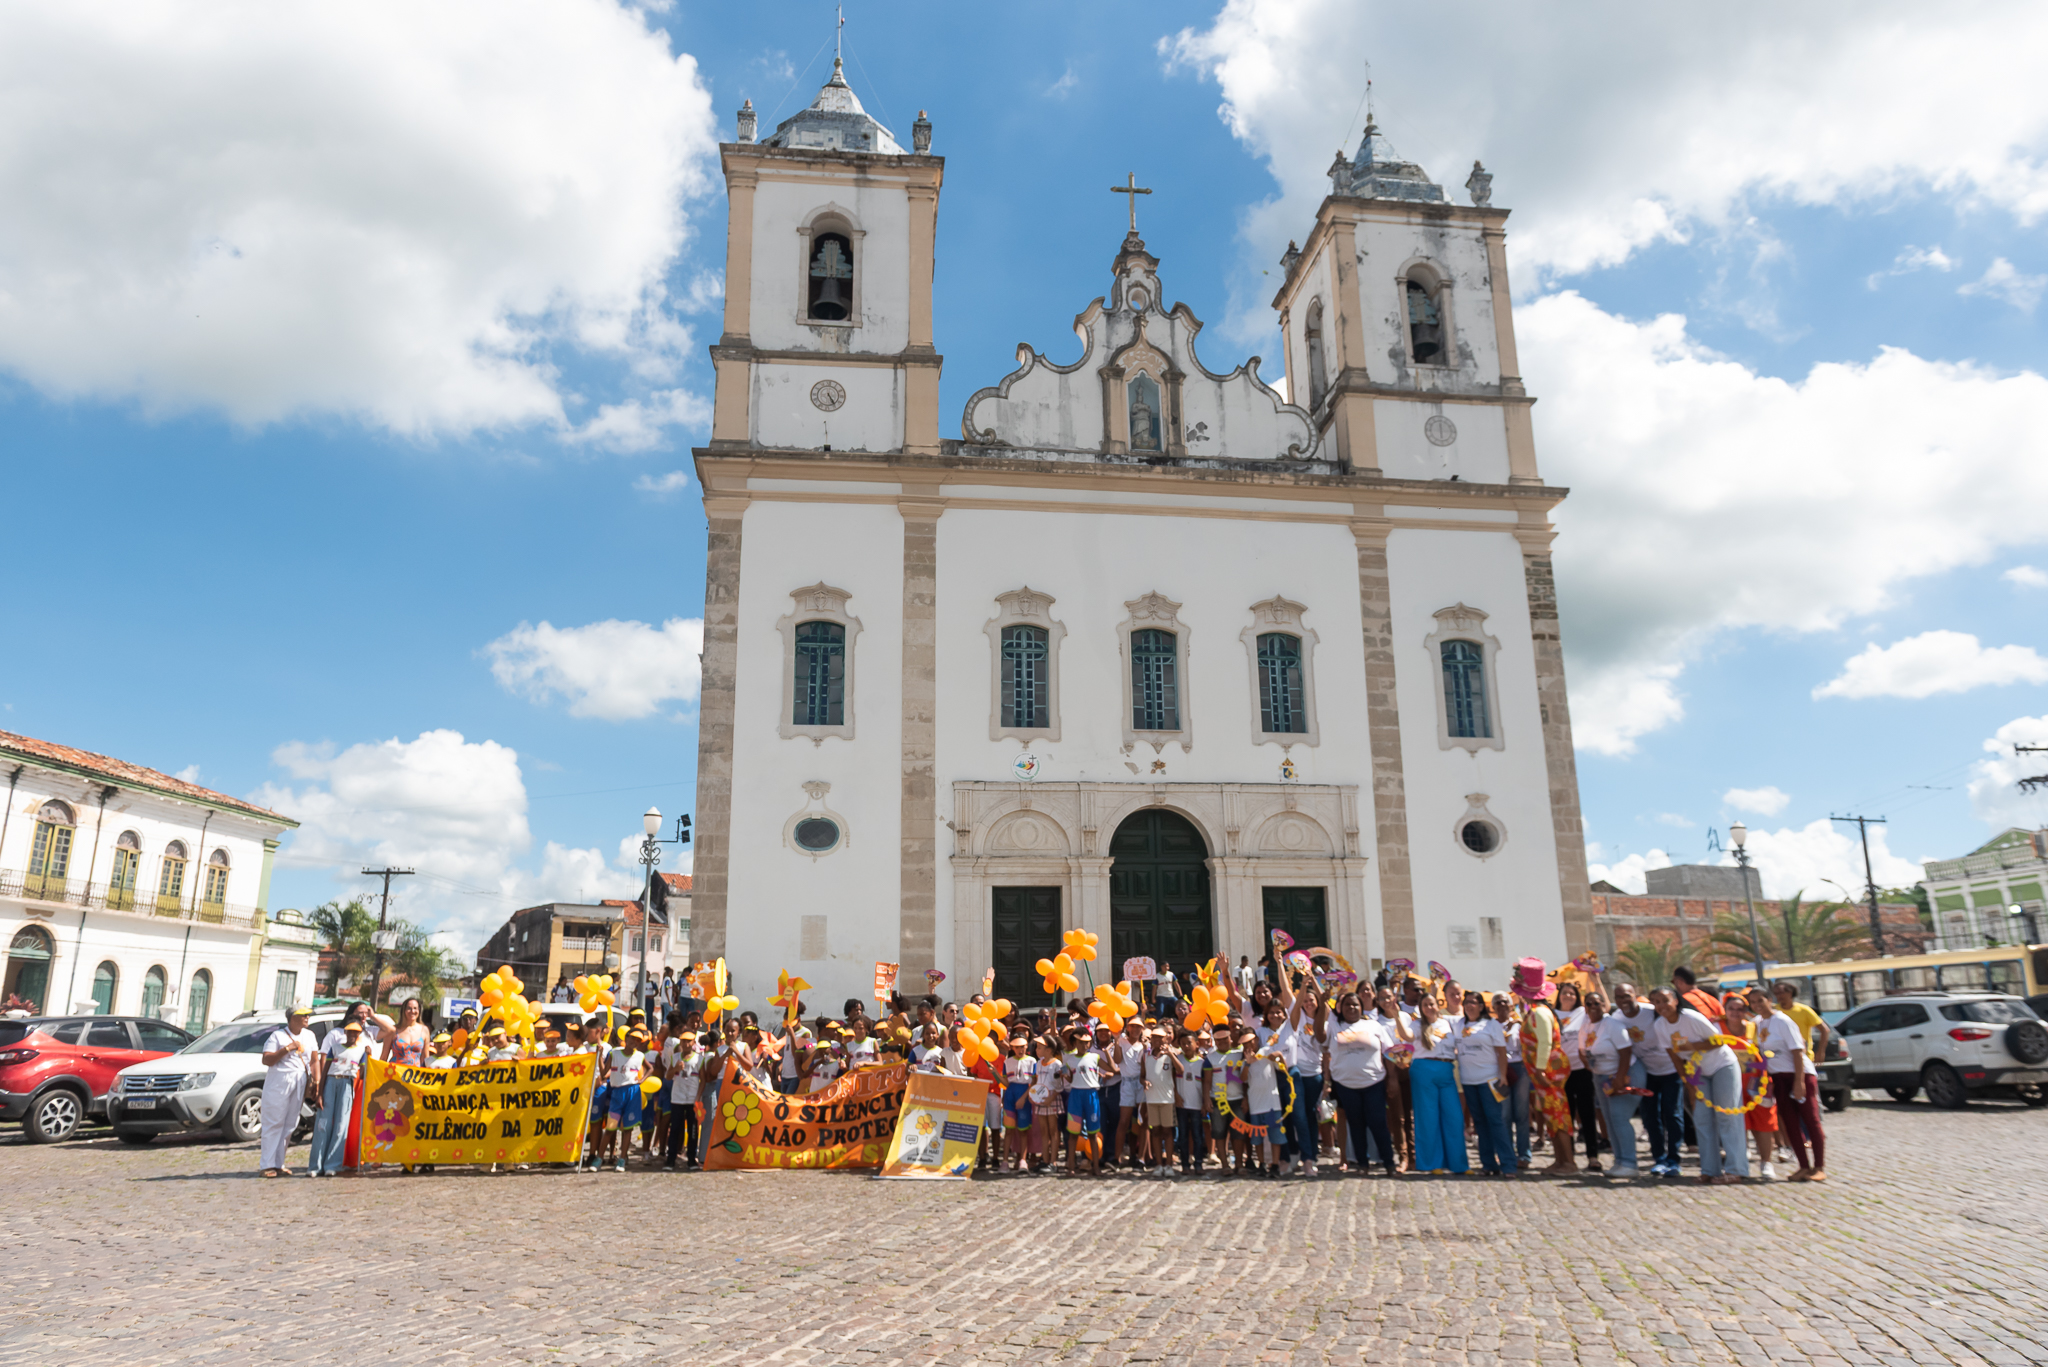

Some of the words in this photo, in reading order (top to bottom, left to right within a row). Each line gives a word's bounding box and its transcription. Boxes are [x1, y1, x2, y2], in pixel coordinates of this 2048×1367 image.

[401, 1068, 448, 1086] QUEM
[455, 1066, 517, 1086] ESCUTA
[529, 1063, 565, 1082] UMA
[803, 1063, 907, 1105] BONITO
[422, 1092, 491, 1114] CRIANÇA
[500, 1089, 561, 1110] IMPEDE
[570, 1087, 580, 1106] O
[414, 1116, 487, 1141] SILÊNCIO
[501, 1120, 521, 1138] DA
[535, 1117, 563, 1137] DOR
[761, 1125, 806, 1146] NÃO
[742, 1144, 849, 1168] ATITUDE
